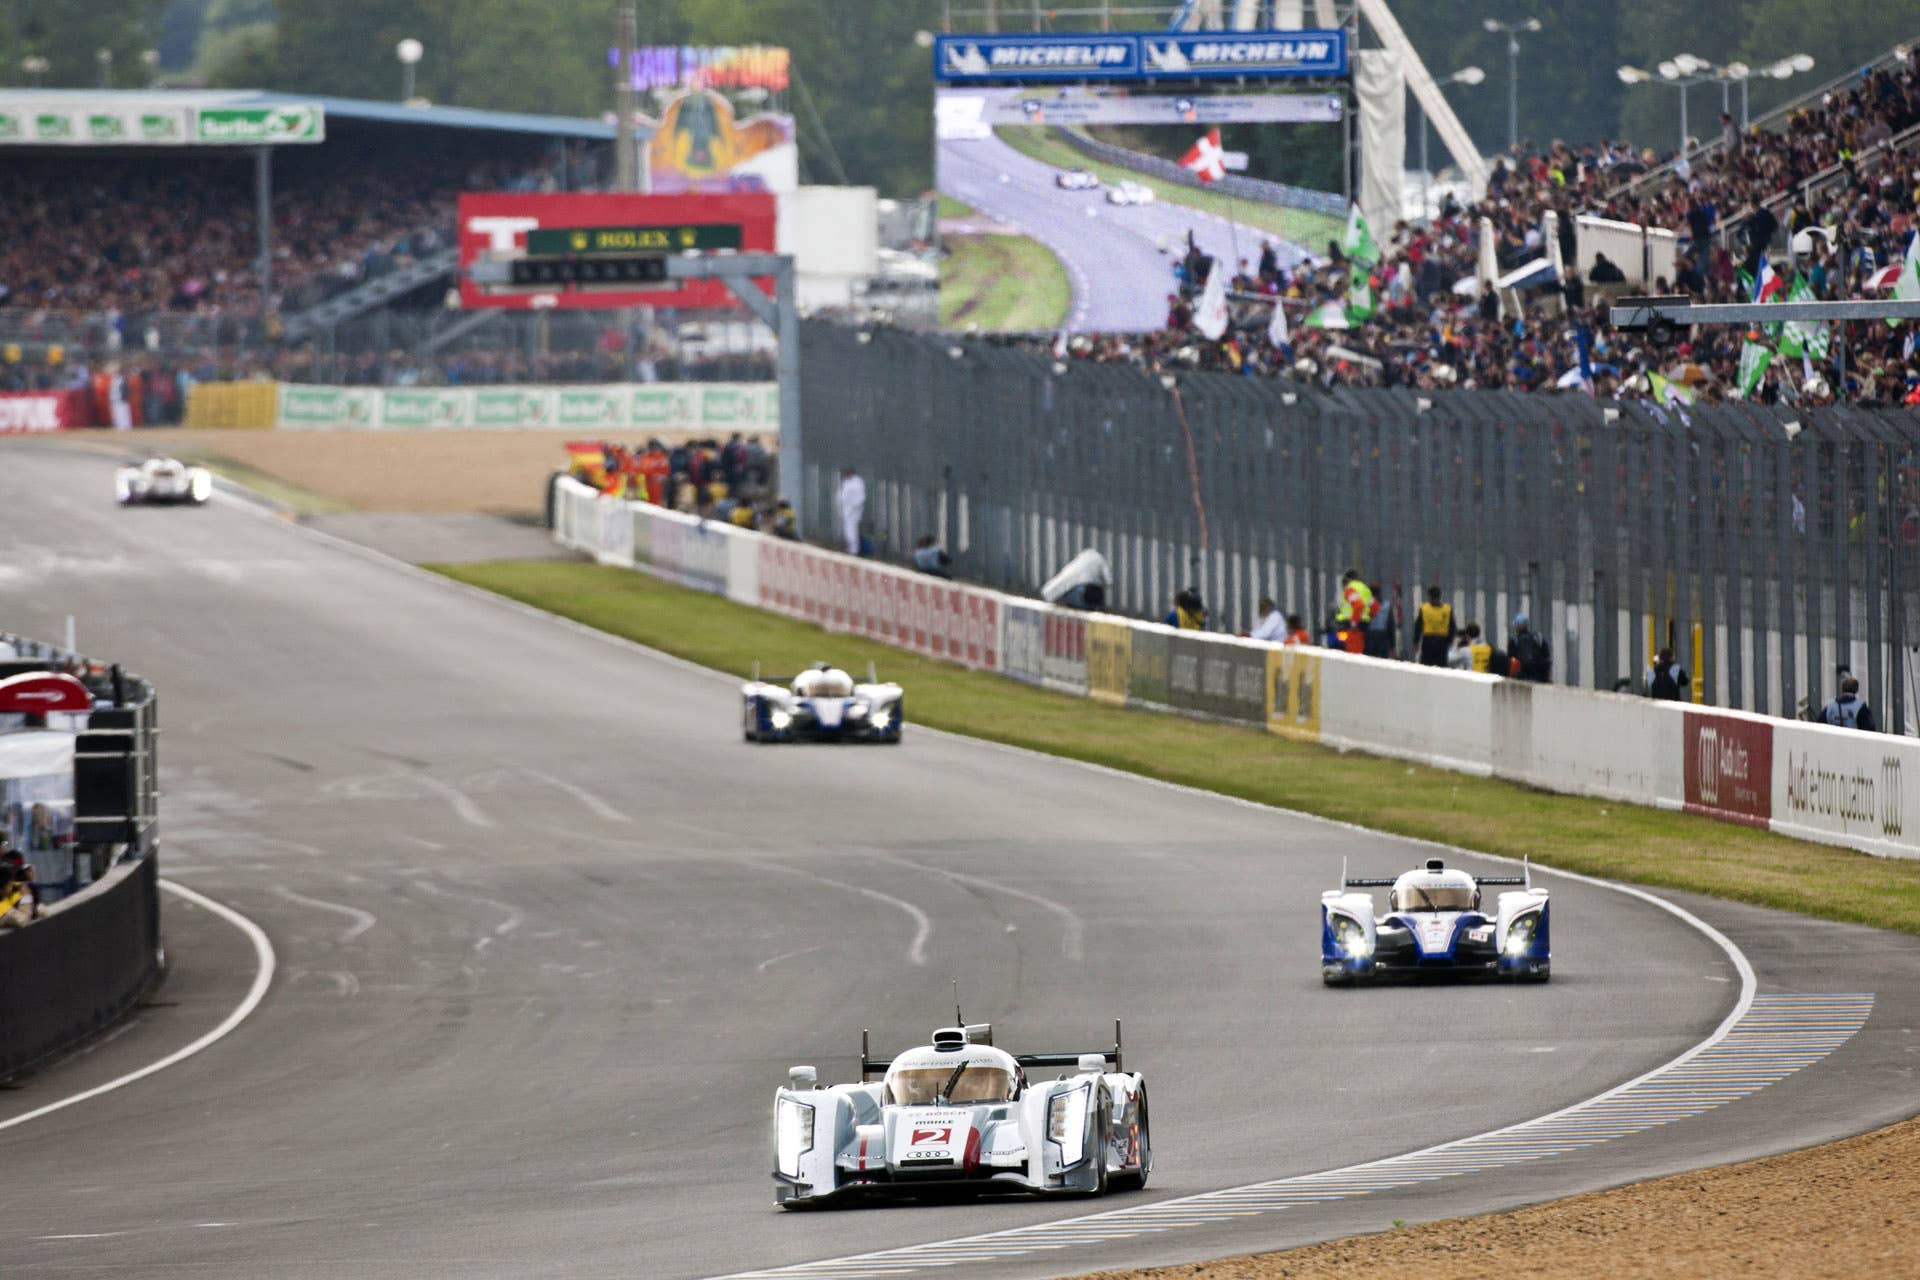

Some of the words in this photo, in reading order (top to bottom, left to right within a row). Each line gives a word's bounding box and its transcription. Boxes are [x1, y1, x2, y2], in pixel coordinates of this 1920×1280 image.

[990, 45, 1127, 65] MICHELIN
[1190, 41, 1329, 62] MICHELIN
[595, 230, 670, 249] ROLEX
[1787, 748, 1808, 812] Audi
[1810, 760, 1836, 816] e-tron
[1840, 765, 1875, 834] quattro
[912, 1128, 948, 1145] 2
